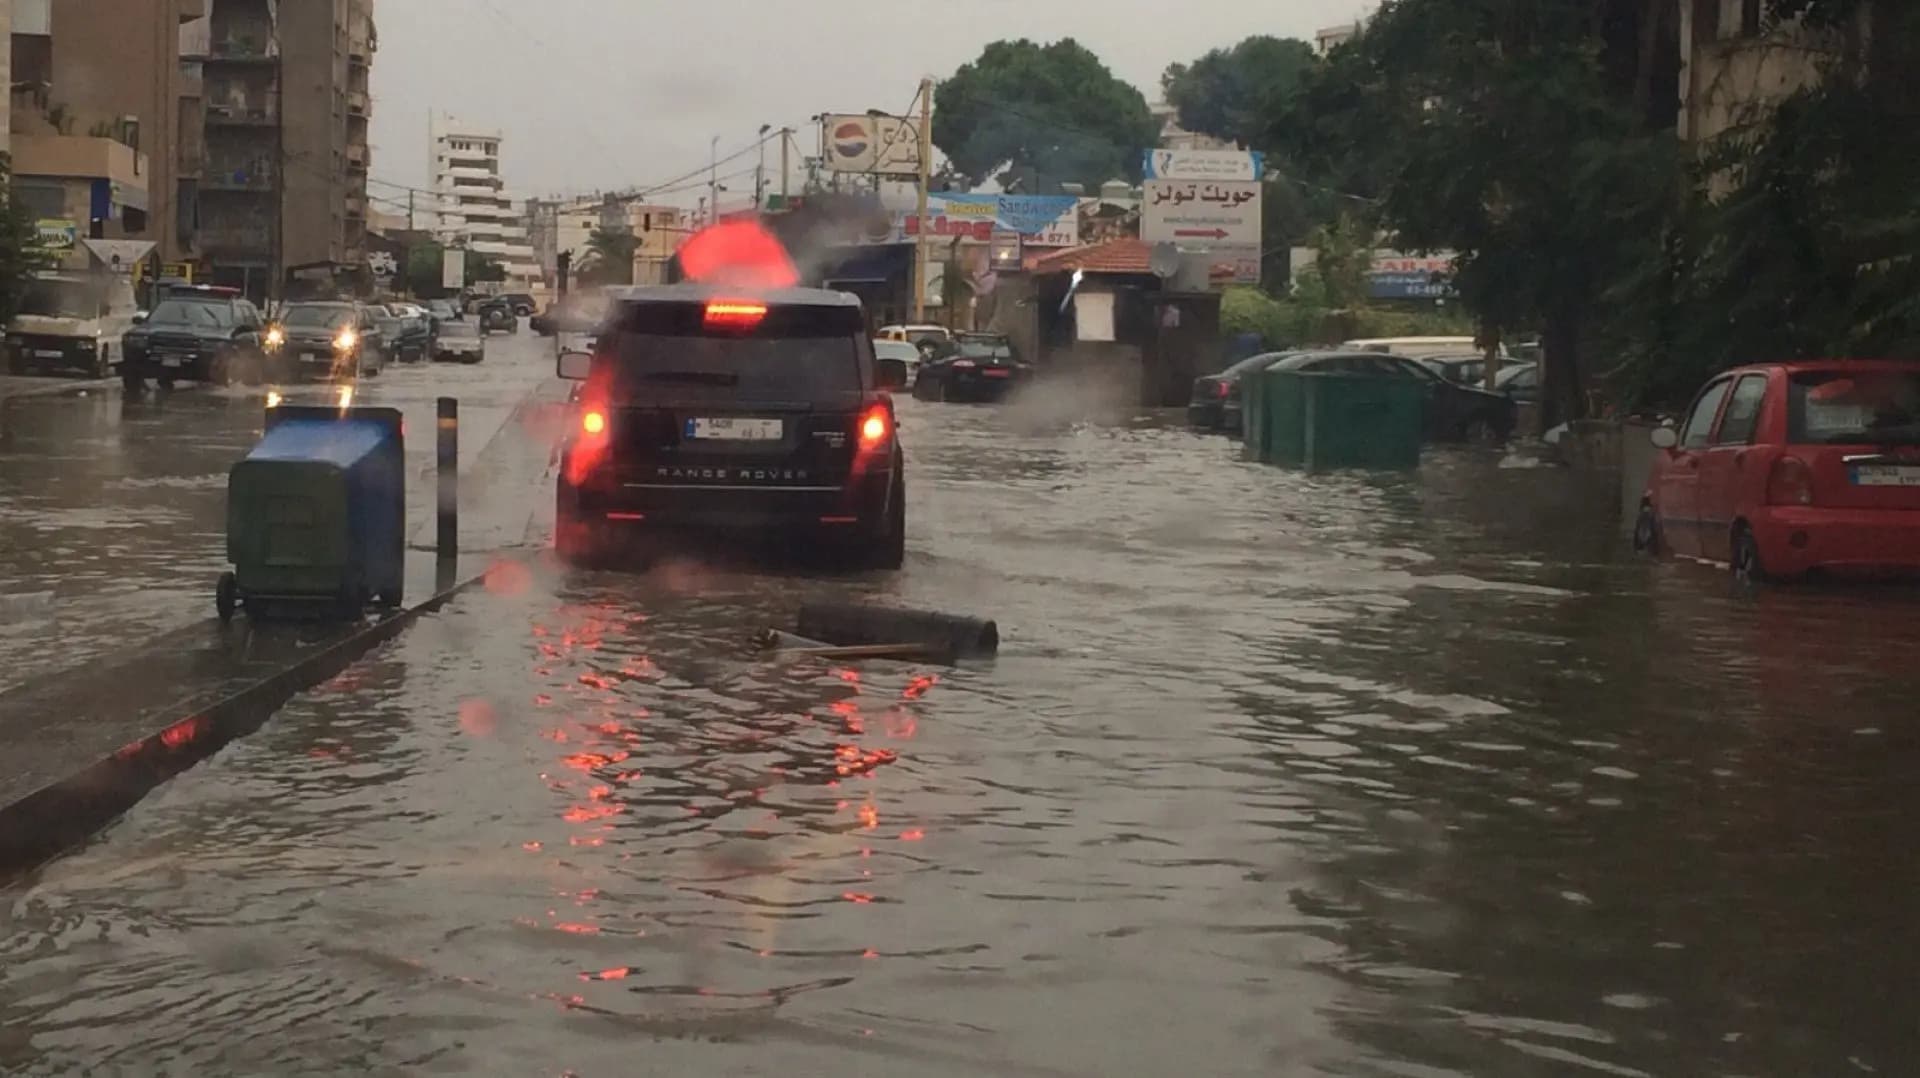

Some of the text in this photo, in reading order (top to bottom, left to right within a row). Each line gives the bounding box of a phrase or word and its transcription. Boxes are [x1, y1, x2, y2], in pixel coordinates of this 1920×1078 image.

[1152, 184, 1255, 208] حويك تولز
[657, 468, 808, 480] RANGE ROVER
